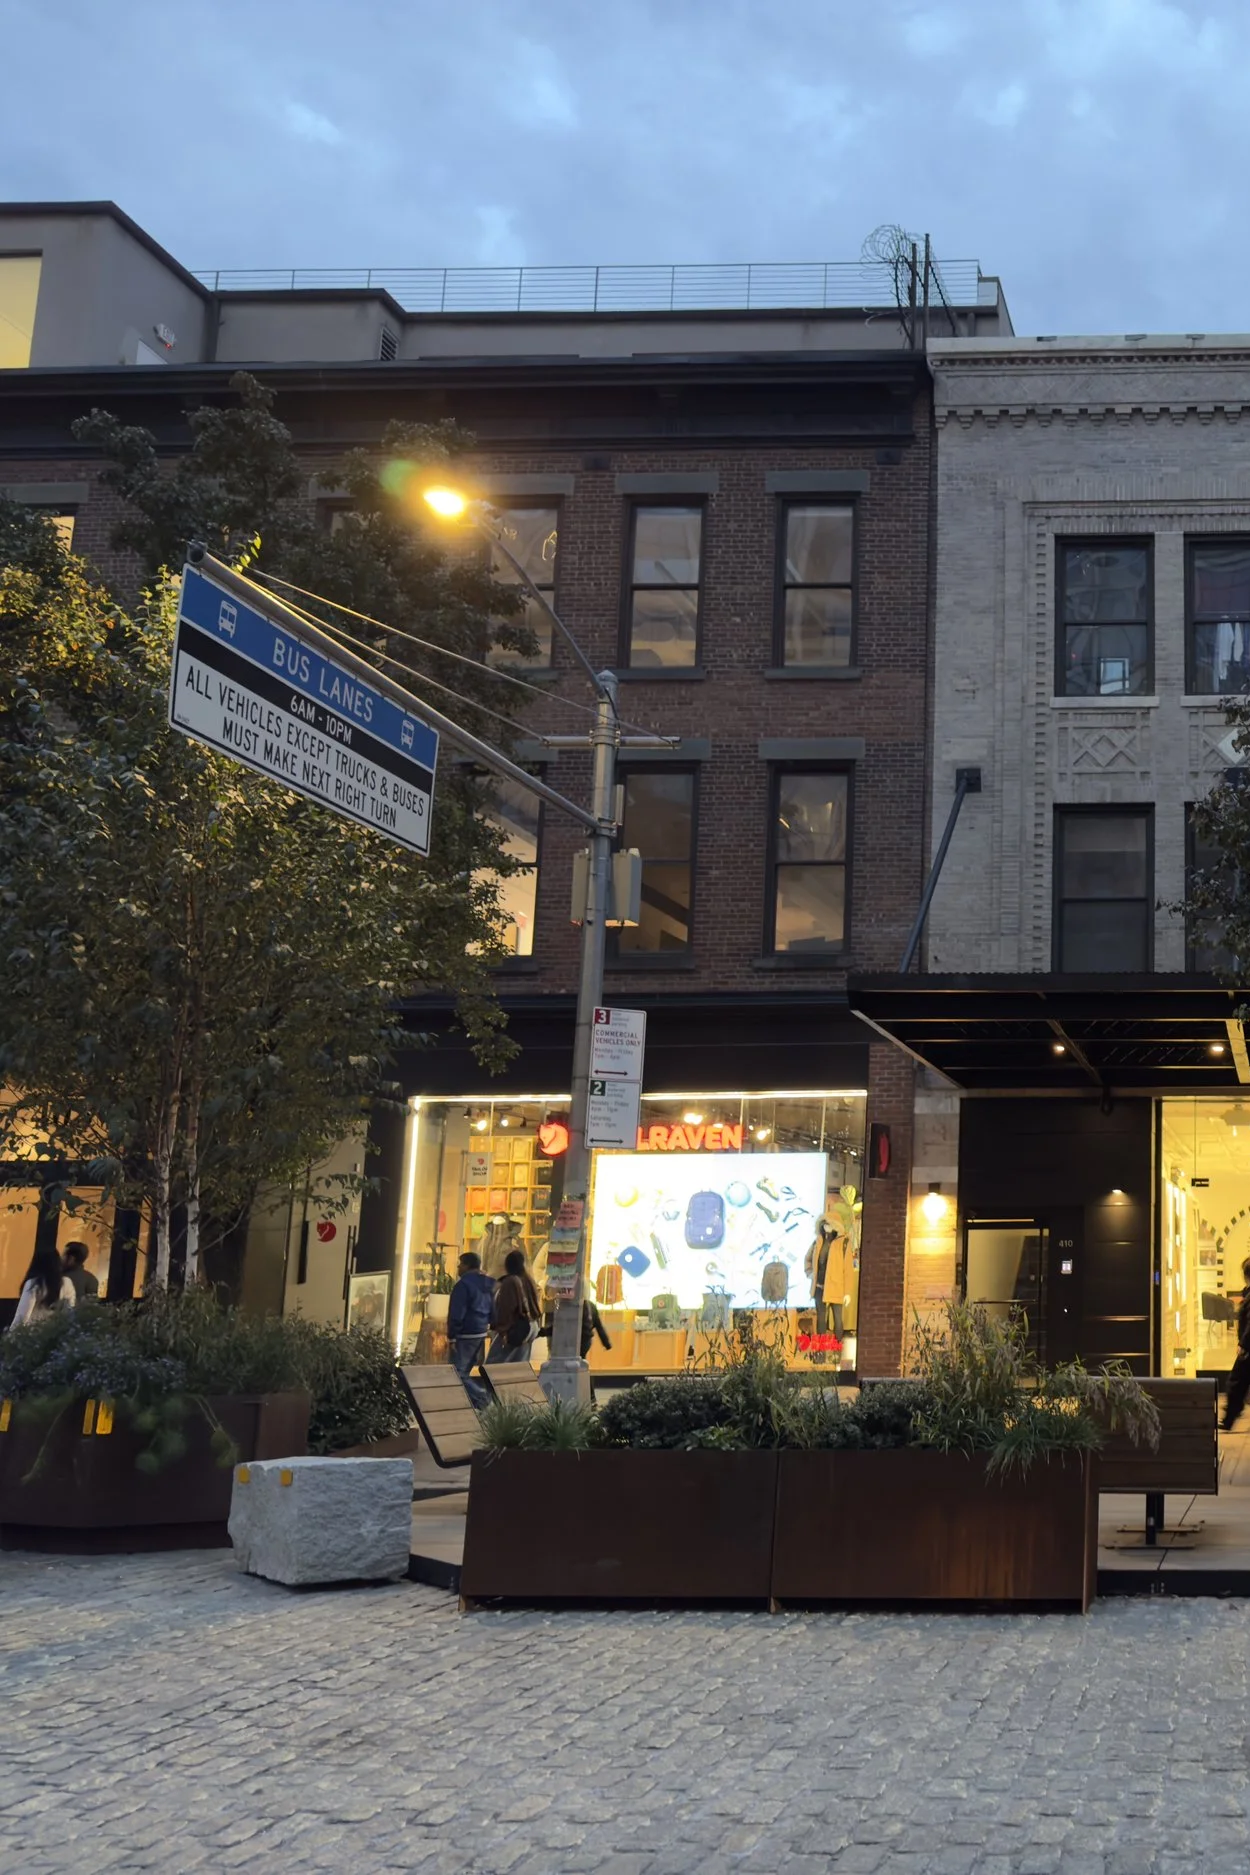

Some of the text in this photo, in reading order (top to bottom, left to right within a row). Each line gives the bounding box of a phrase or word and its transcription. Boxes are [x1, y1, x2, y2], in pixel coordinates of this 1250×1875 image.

[272, 638, 374, 723] BUS LANES
[290, 694, 316, 724] 6AM
[326, 714, 353, 746] 10PM
[185, 665, 425, 817] ALL VEHICLES EXCEPT TRUCKS & BUSES
[222, 716, 397, 828] MUST MAKE NEXT RIGHT TURN
[598, 1010, 607, 1024] 3
[595, 1029, 638, 1039] COMMERCIAL
[595, 1037, 624, 1046] VEHICLES
[593, 1081, 602, 1095] 2
[637, 1125, 743, 1151] LRÄVEN
[1059, 1239, 1073, 1248] 410
